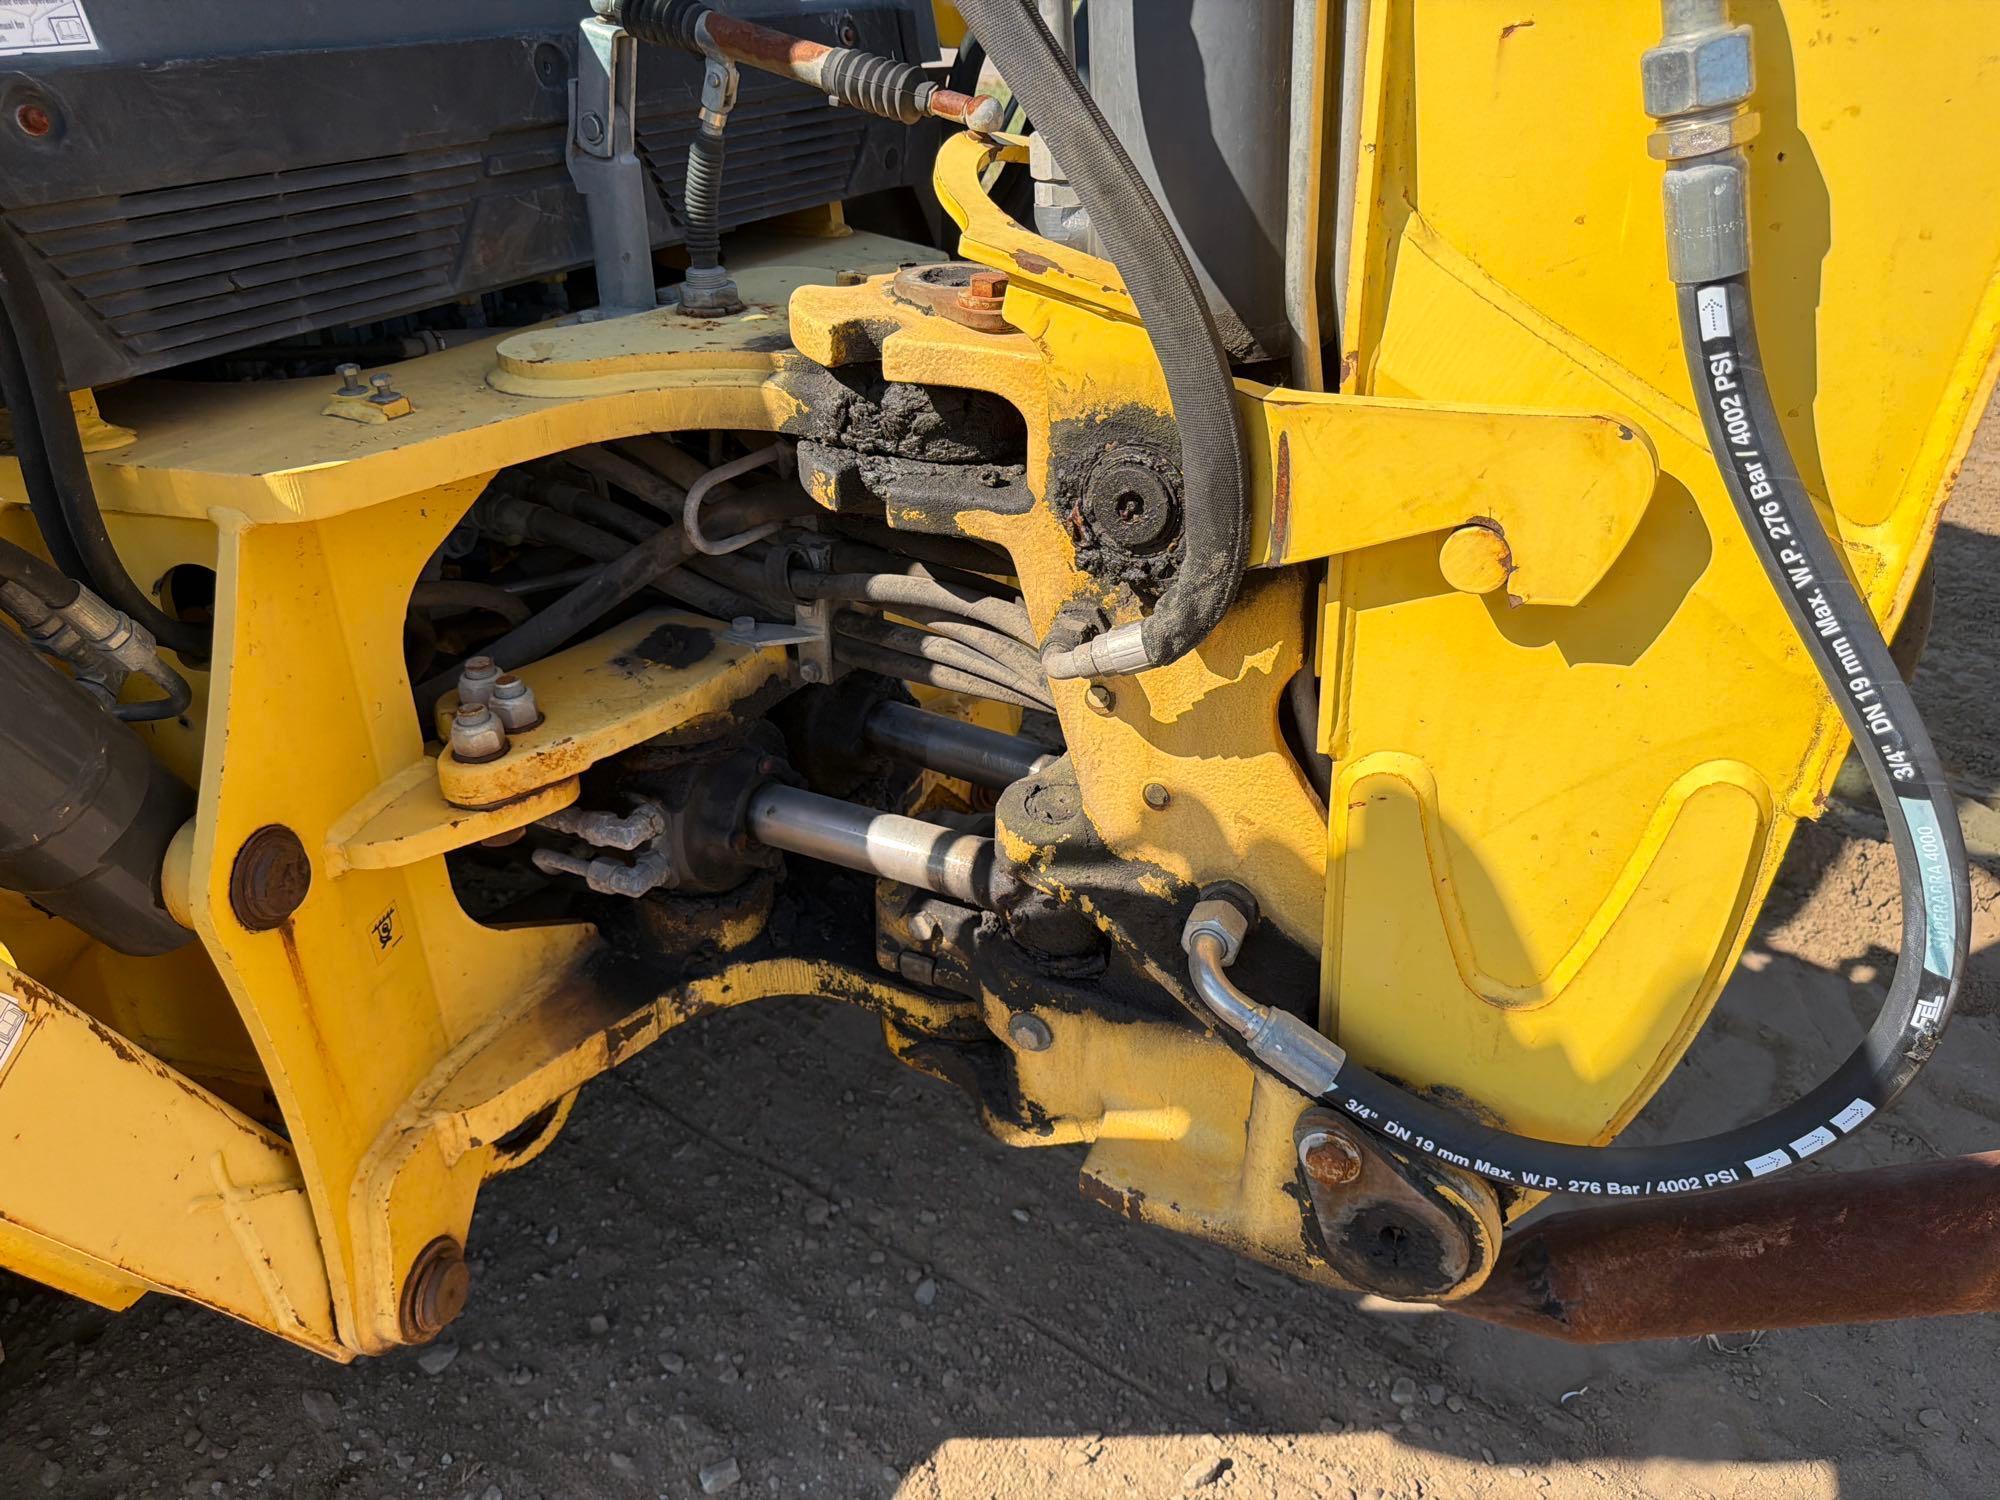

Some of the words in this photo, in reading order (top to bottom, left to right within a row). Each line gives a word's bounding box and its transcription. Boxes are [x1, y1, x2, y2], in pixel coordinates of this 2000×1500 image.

[1709, 352, 1736, 391] PSI
[1720, 394, 1750, 446] 4002
[1744, 463, 1772, 500] Bar
[1759, 501, 1791, 540] 276
[1780, 540, 1814, 590] W.P.
[1807, 588, 1841, 637] Max.
[1832, 636, 1863, 675] mm
[1849, 677, 1875, 702] 19
[1862, 702, 1894, 735] DN
[1881, 744, 1915, 781] 3/4"
[1916, 826, 1941, 862] 4000
[1344, 1098, 1379, 1120] 3/4"
[1383, 1120, 1411, 1142] DN
[1415, 1135, 1435, 1152] 19
[1436, 1147, 1469, 1167] mm
[1474, 1158, 1515, 1181] Max.
[1522, 1171, 1563, 1190] W.P.
[1568, 1181, 1601, 1195] 276
[1607, 1182, 1640, 1195] Bar
[1656, 1177, 1702, 1194] 4002
[1704, 1168, 1739, 1186] PSI
